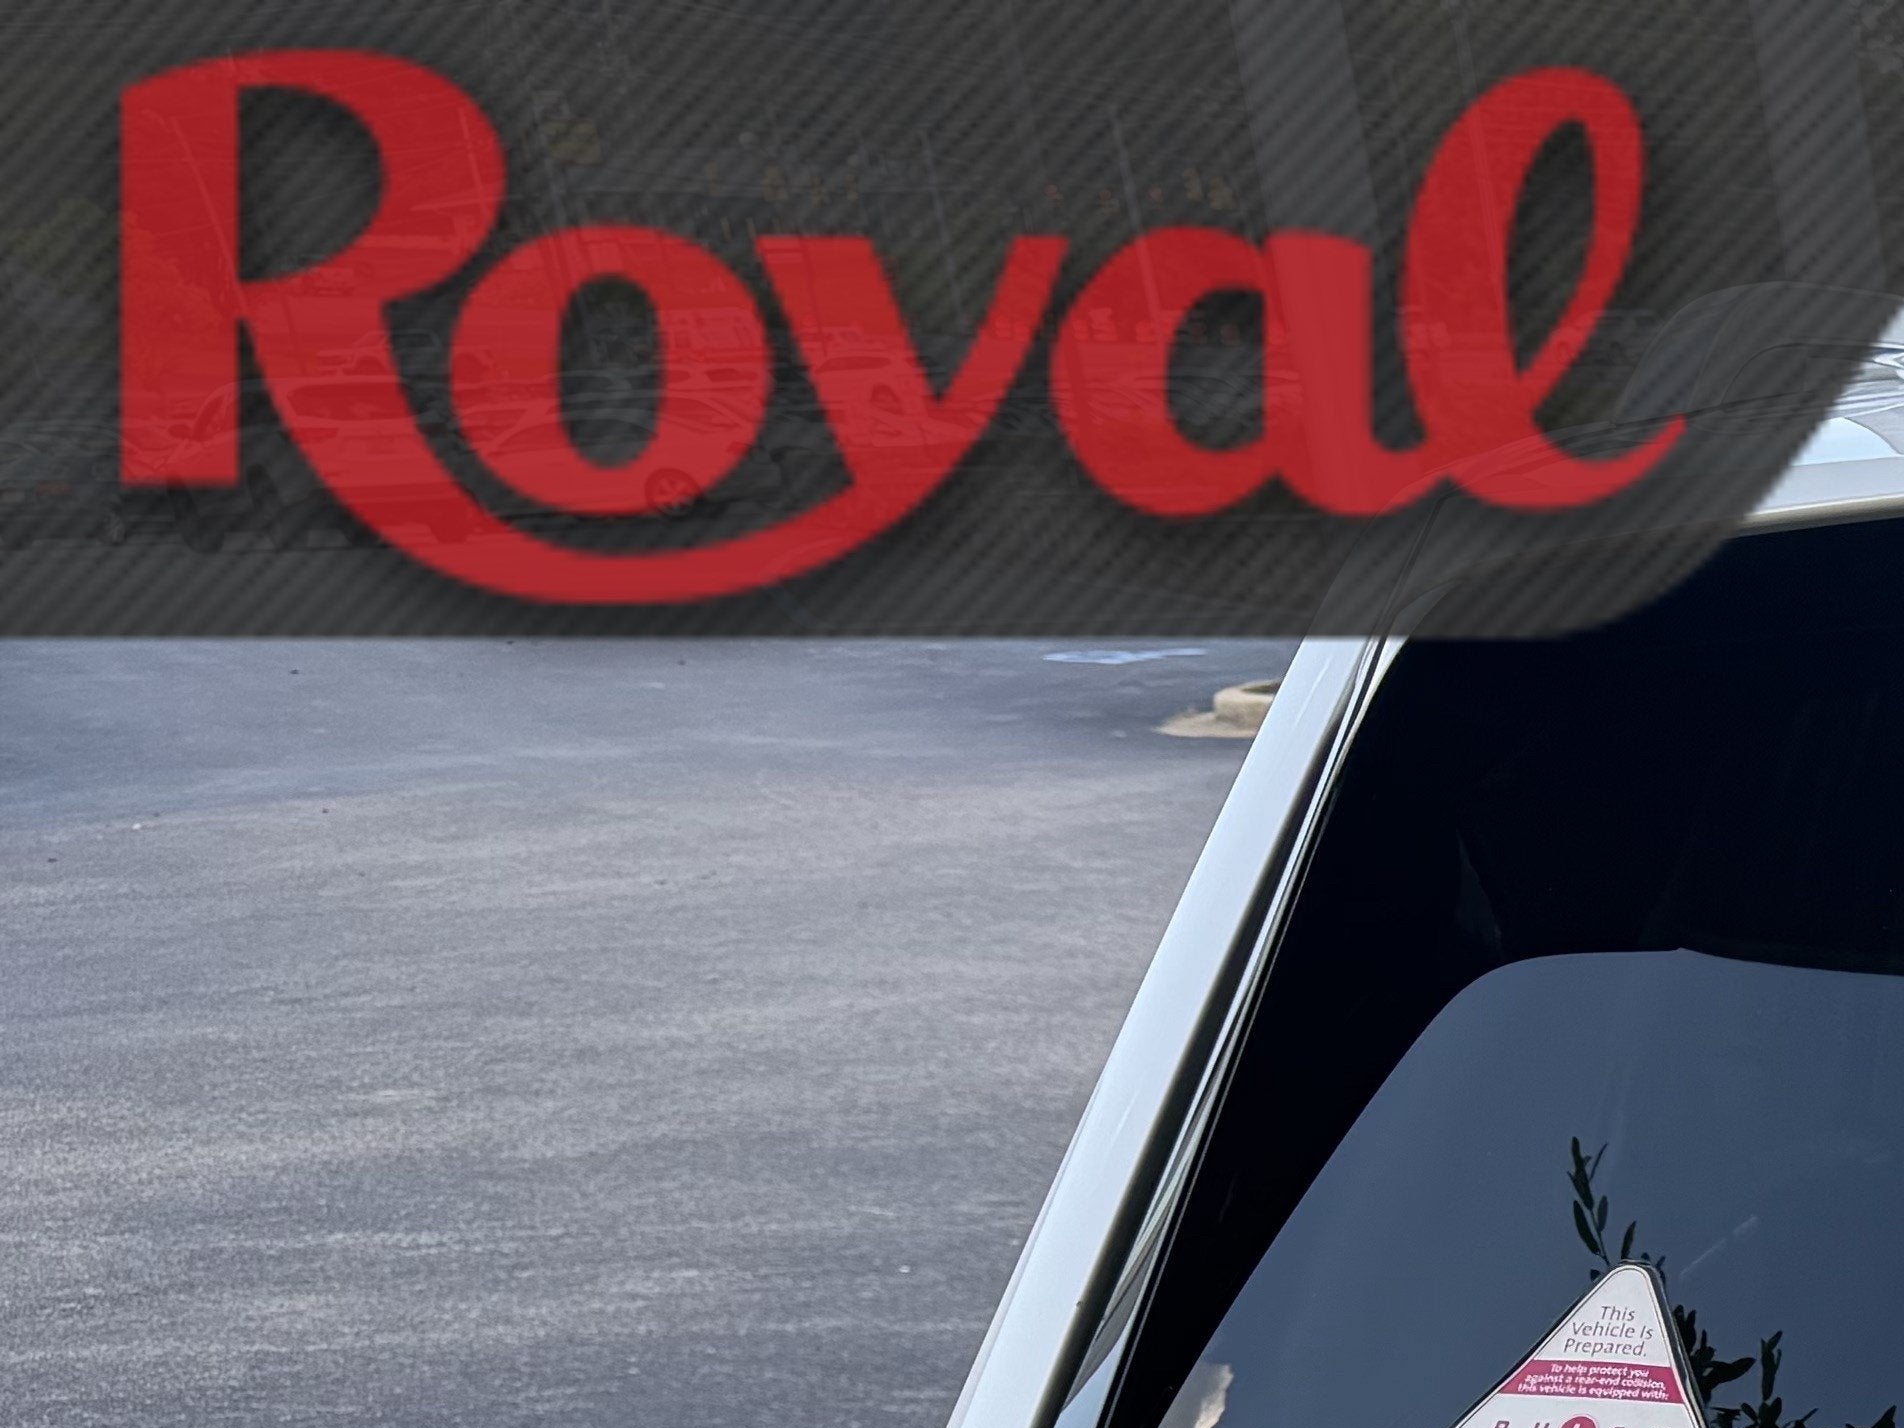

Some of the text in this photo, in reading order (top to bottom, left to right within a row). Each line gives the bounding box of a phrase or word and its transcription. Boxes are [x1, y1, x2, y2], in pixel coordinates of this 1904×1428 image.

[1601, 1305, 1636, 1322] This
[1572, 1321, 1654, 1340] Vehicle Is
[1563, 1338, 1647, 1357] Prepared.
[1551, 1363, 1650, 1379] To help protect you
[1539, 1384, 1576, 1395] vehicle
[1588, 1386, 1640, 1400] equipped
